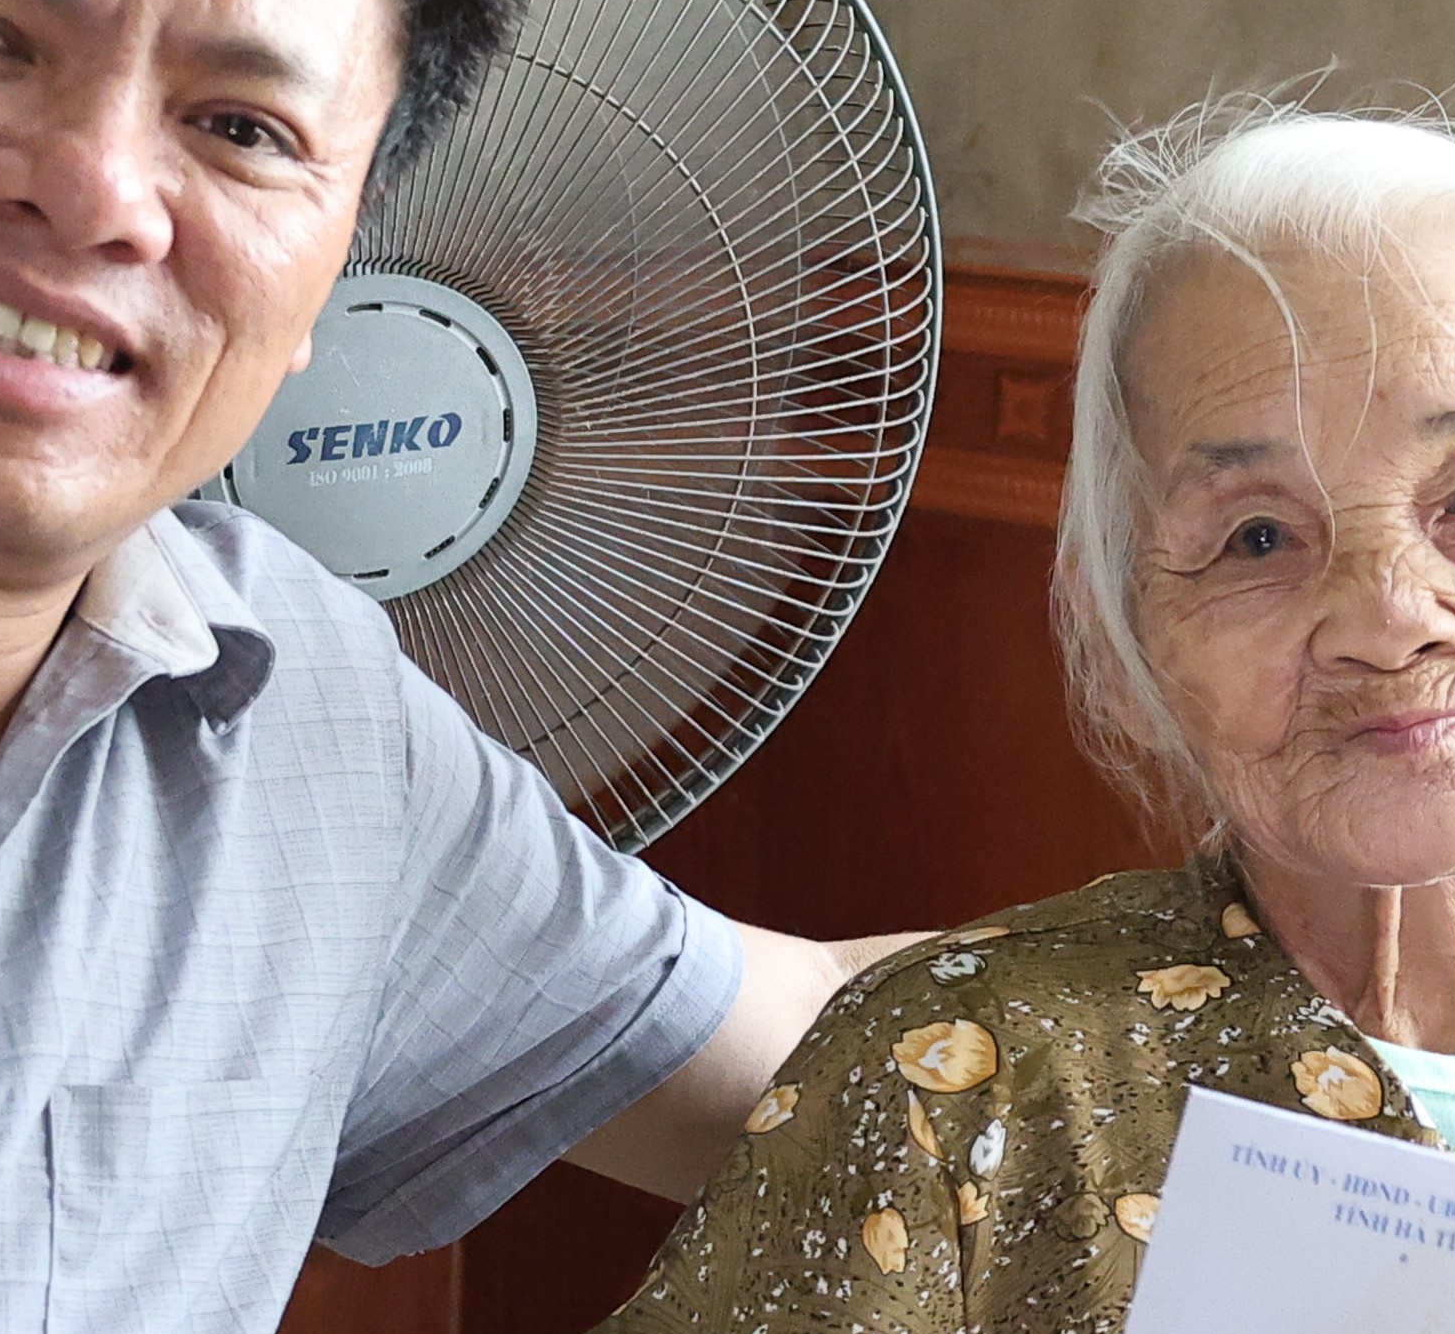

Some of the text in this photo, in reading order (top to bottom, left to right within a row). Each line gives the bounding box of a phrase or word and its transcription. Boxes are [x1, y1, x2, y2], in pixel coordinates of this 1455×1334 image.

[287, 412, 462, 465] SENKO
[308, 469, 338, 487] ISO
[341, 464, 378, 483] 9001
[1342, 1173, 1410, 1206] HĐND
[1395, 1218, 1426, 1246] HÀ
